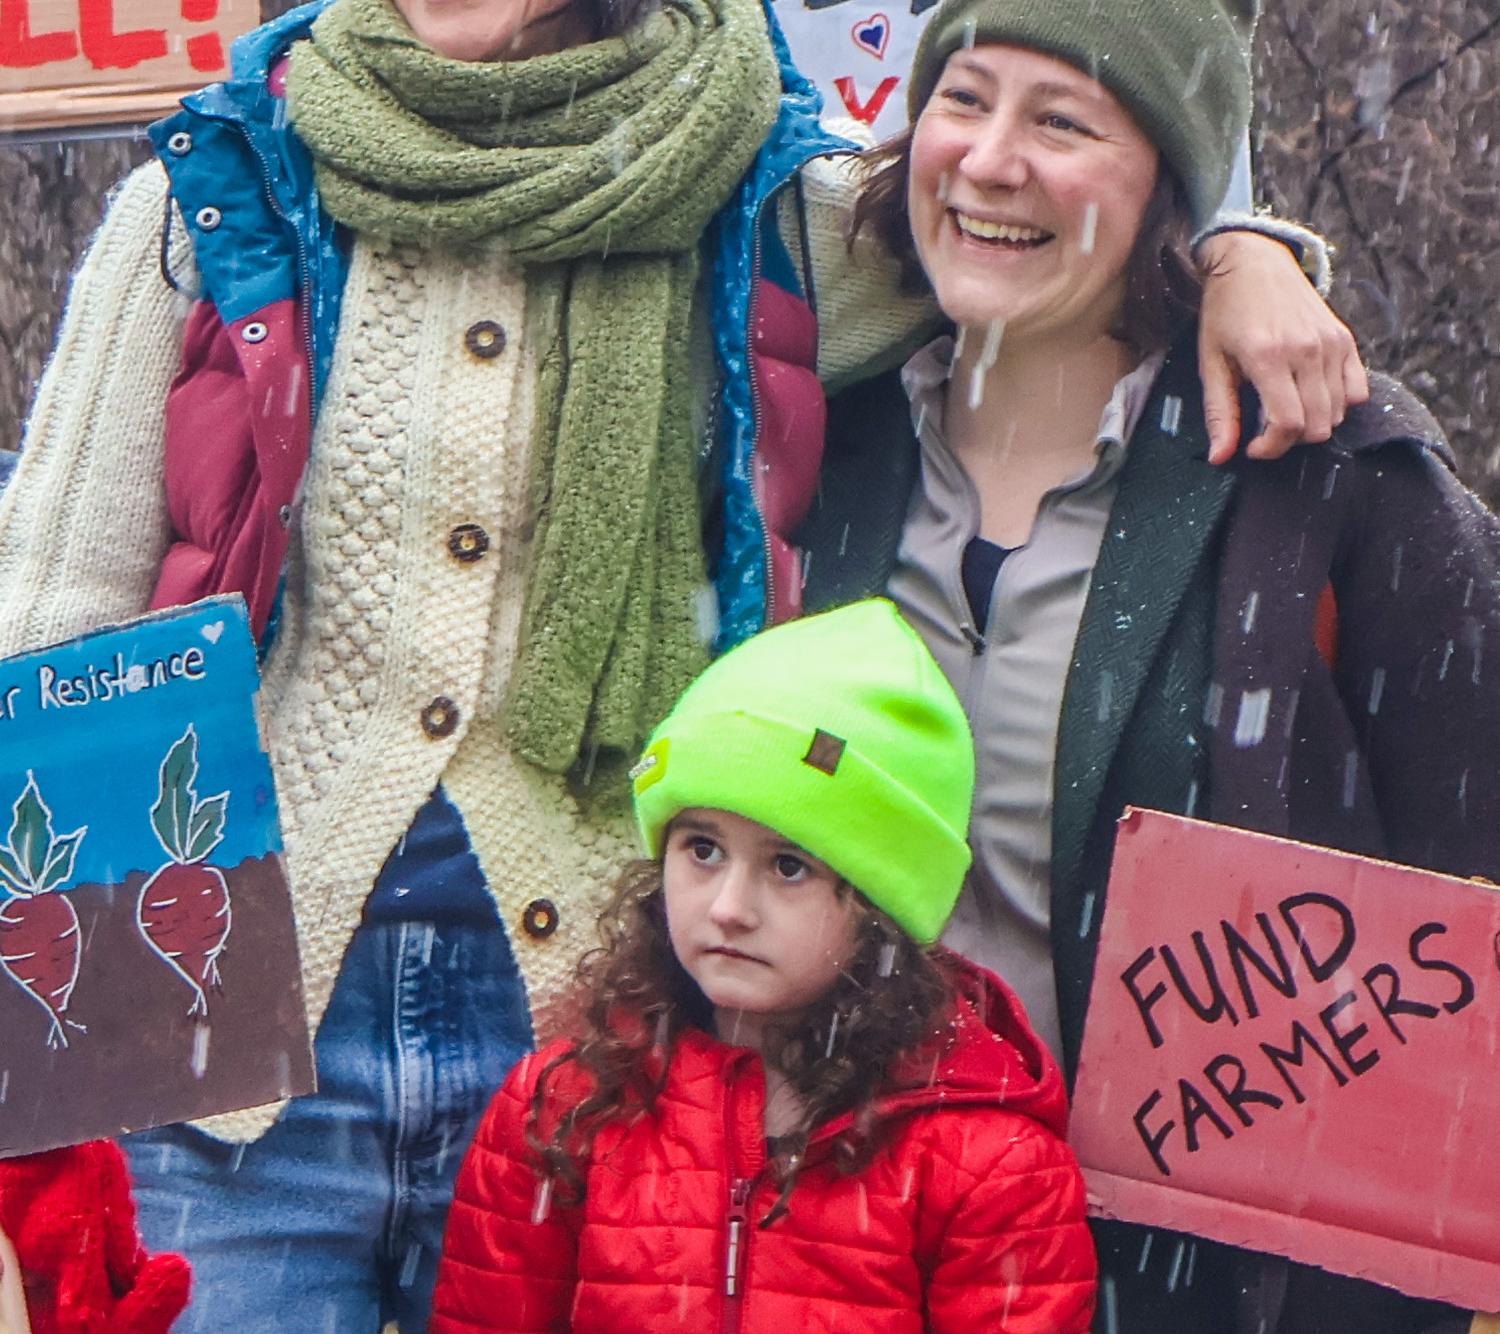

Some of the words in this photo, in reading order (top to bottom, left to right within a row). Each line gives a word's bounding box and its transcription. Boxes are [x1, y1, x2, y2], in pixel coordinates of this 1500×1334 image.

[38, 644, 206, 710] Resistance
[1121, 890, 1357, 1048] FUND
[1134, 921, 1476, 1176] FARMERS
